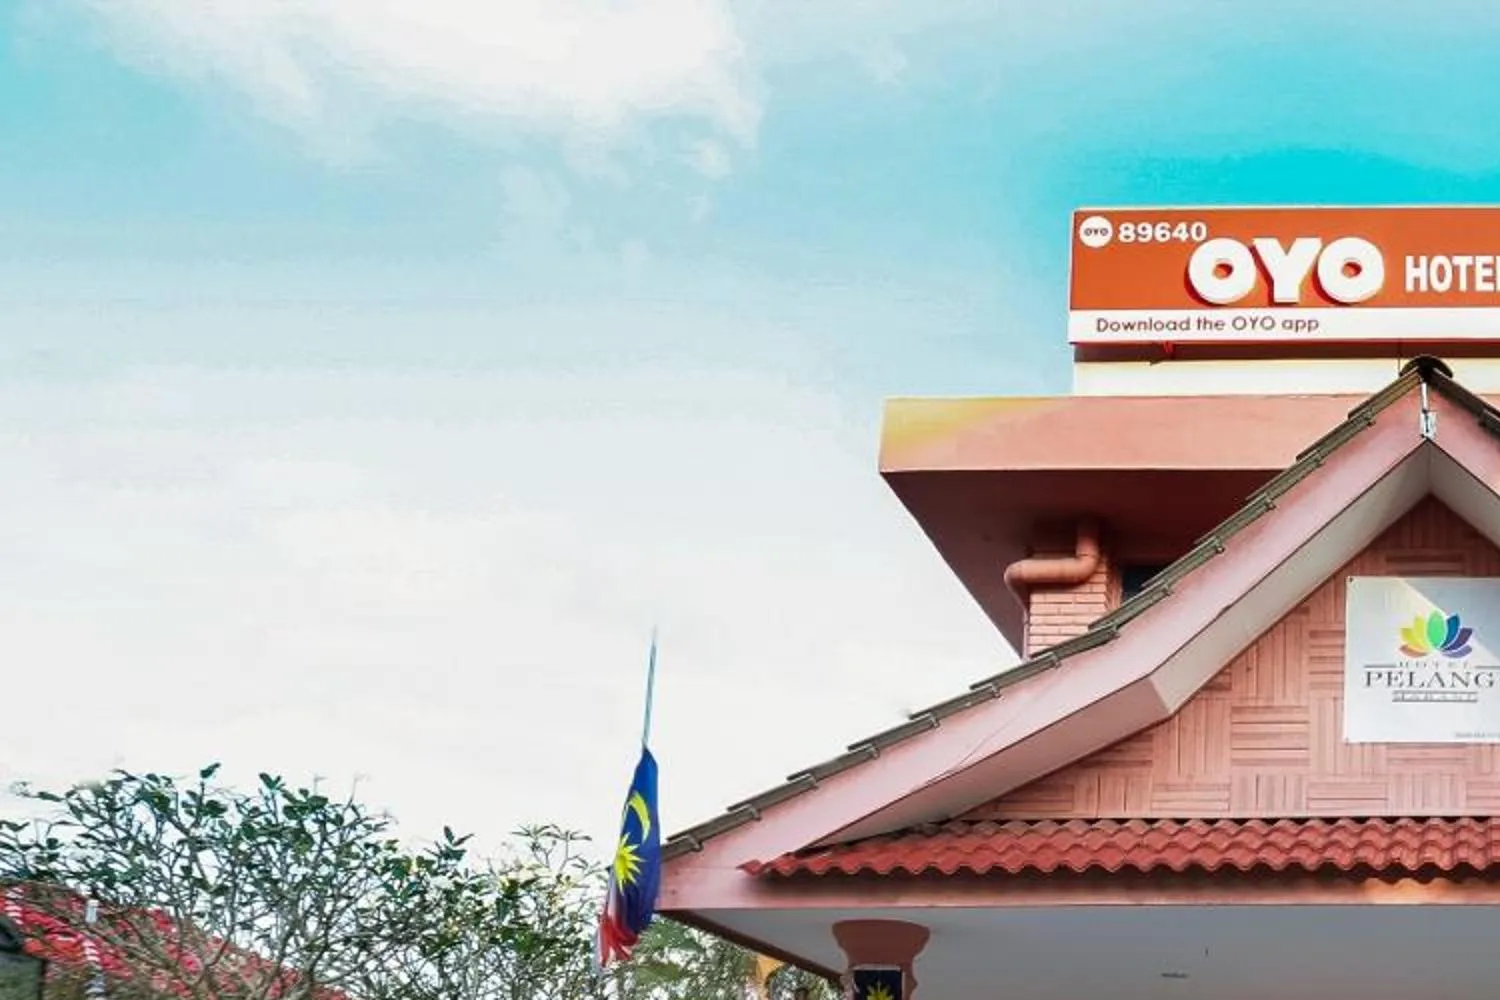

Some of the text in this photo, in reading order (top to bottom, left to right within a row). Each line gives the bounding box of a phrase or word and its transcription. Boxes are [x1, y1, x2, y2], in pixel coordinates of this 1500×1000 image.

[1084, 227, 1109, 237] OYO
[1118, 221, 1208, 243] 89640
[1185, 236, 1386, 305] OYO
[1096, 317, 1320, 333] Download the OYO app
